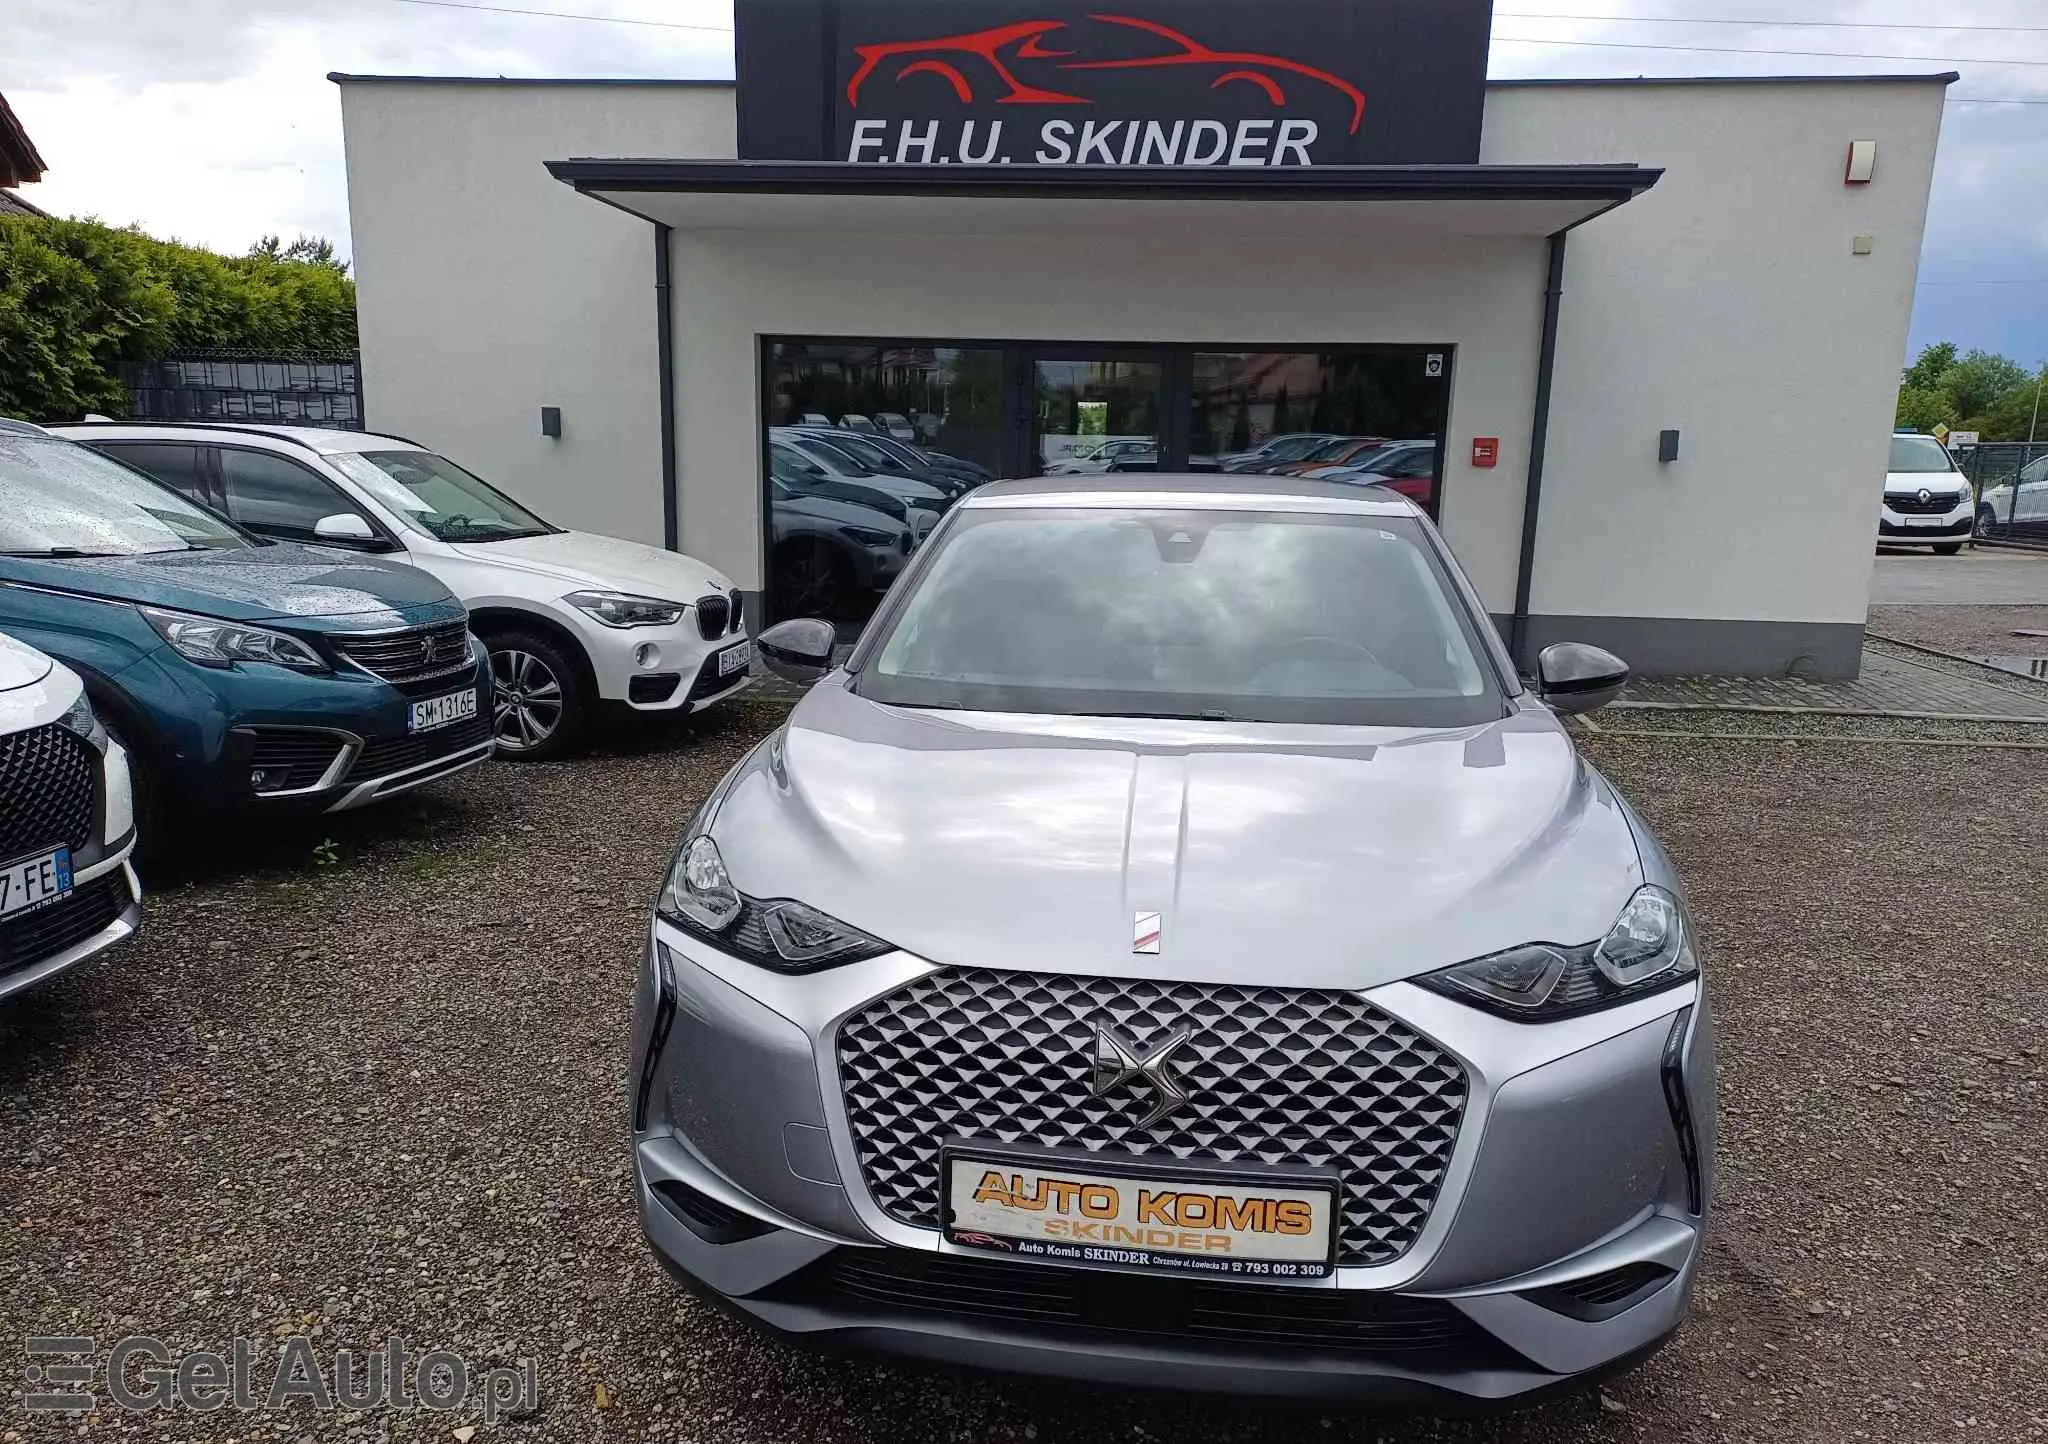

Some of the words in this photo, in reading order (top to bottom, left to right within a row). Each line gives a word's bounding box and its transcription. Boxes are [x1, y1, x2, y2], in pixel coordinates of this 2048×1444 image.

[848, 119, 1011, 164] F.H.U.
[1035, 119, 1318, 166] SKINDER
[972, 1171, 1120, 1220] AUTO
[1138, 1189, 1313, 1236] KOMIS
[1044, 1218, 1232, 1252] SKINDER
[1018, 1241, 1044, 1255] Auto
[1047, 1244, 1081, 1258] Komis
[1084, 1247, 1150, 1265] SKINDER
[1245, 1262, 1270, 1274] 793
[1272, 1264, 1297, 1275] 002
[1300, 1264, 1325, 1276] 309
